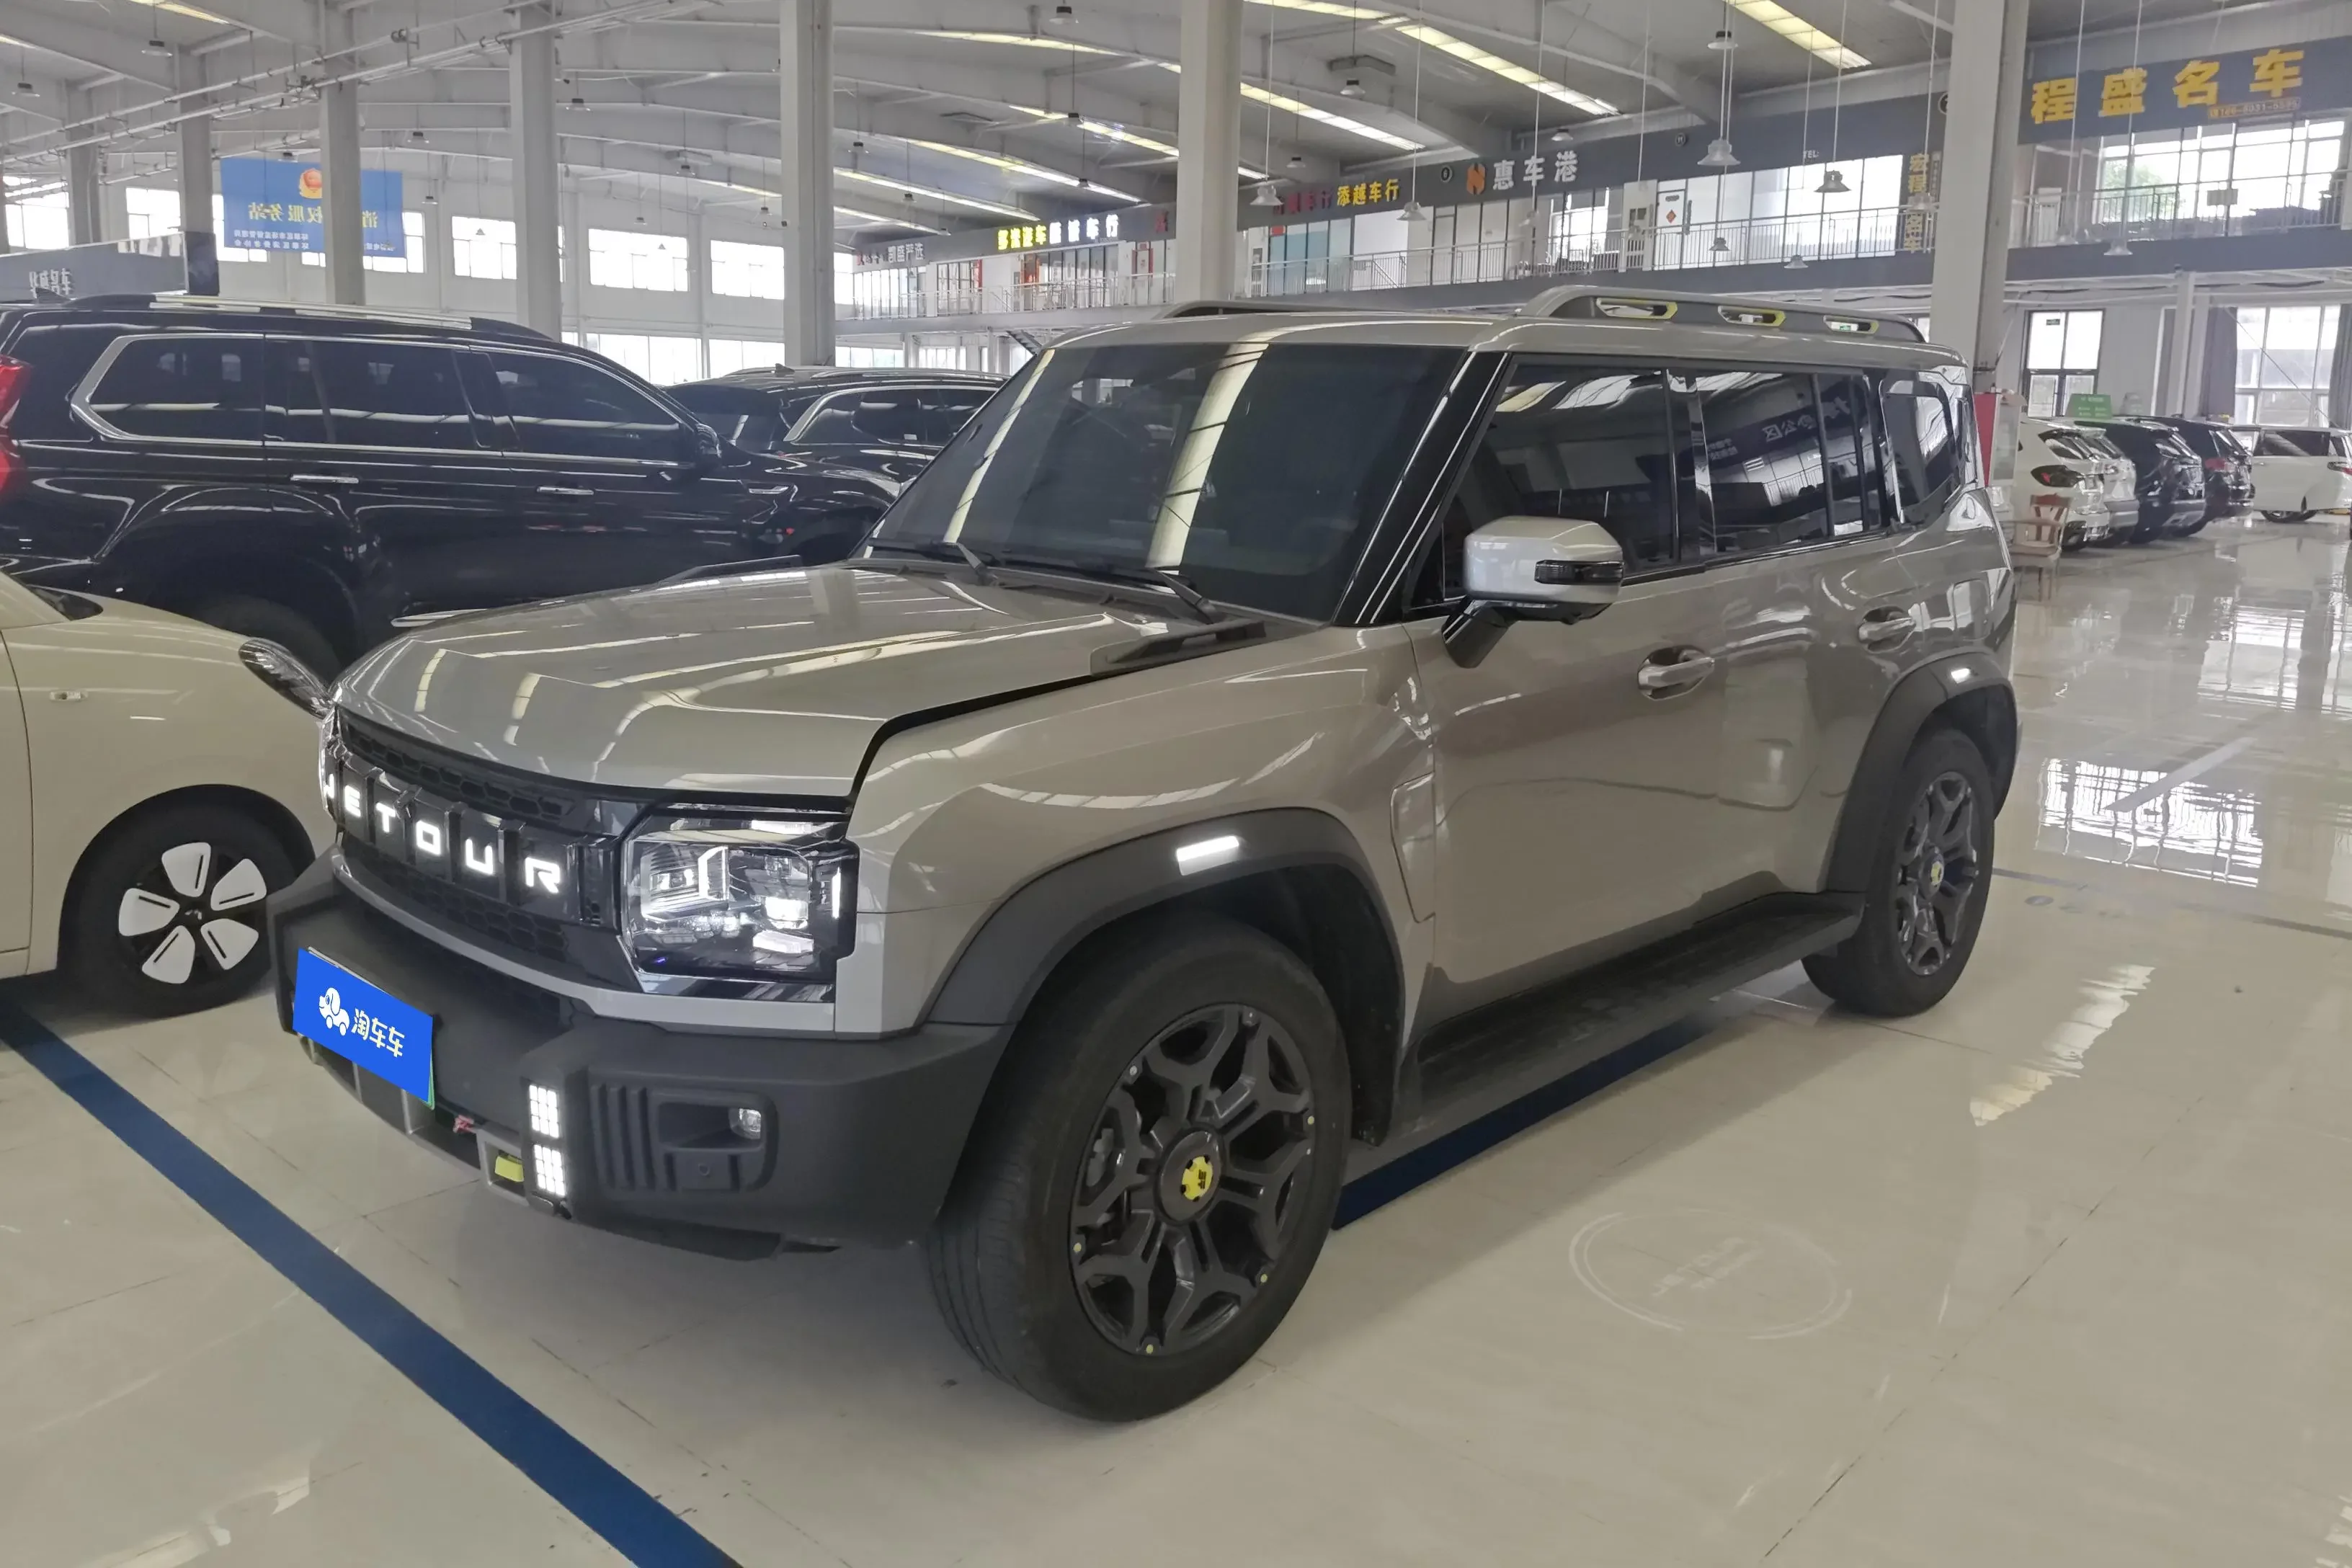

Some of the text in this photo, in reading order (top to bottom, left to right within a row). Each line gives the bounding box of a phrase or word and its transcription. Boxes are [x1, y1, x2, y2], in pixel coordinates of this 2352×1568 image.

[2031, 48, 2304, 125] 程盛名车
[1492, 150, 1577, 190] 惠车港
[324, 772, 561, 894] JETOUR
